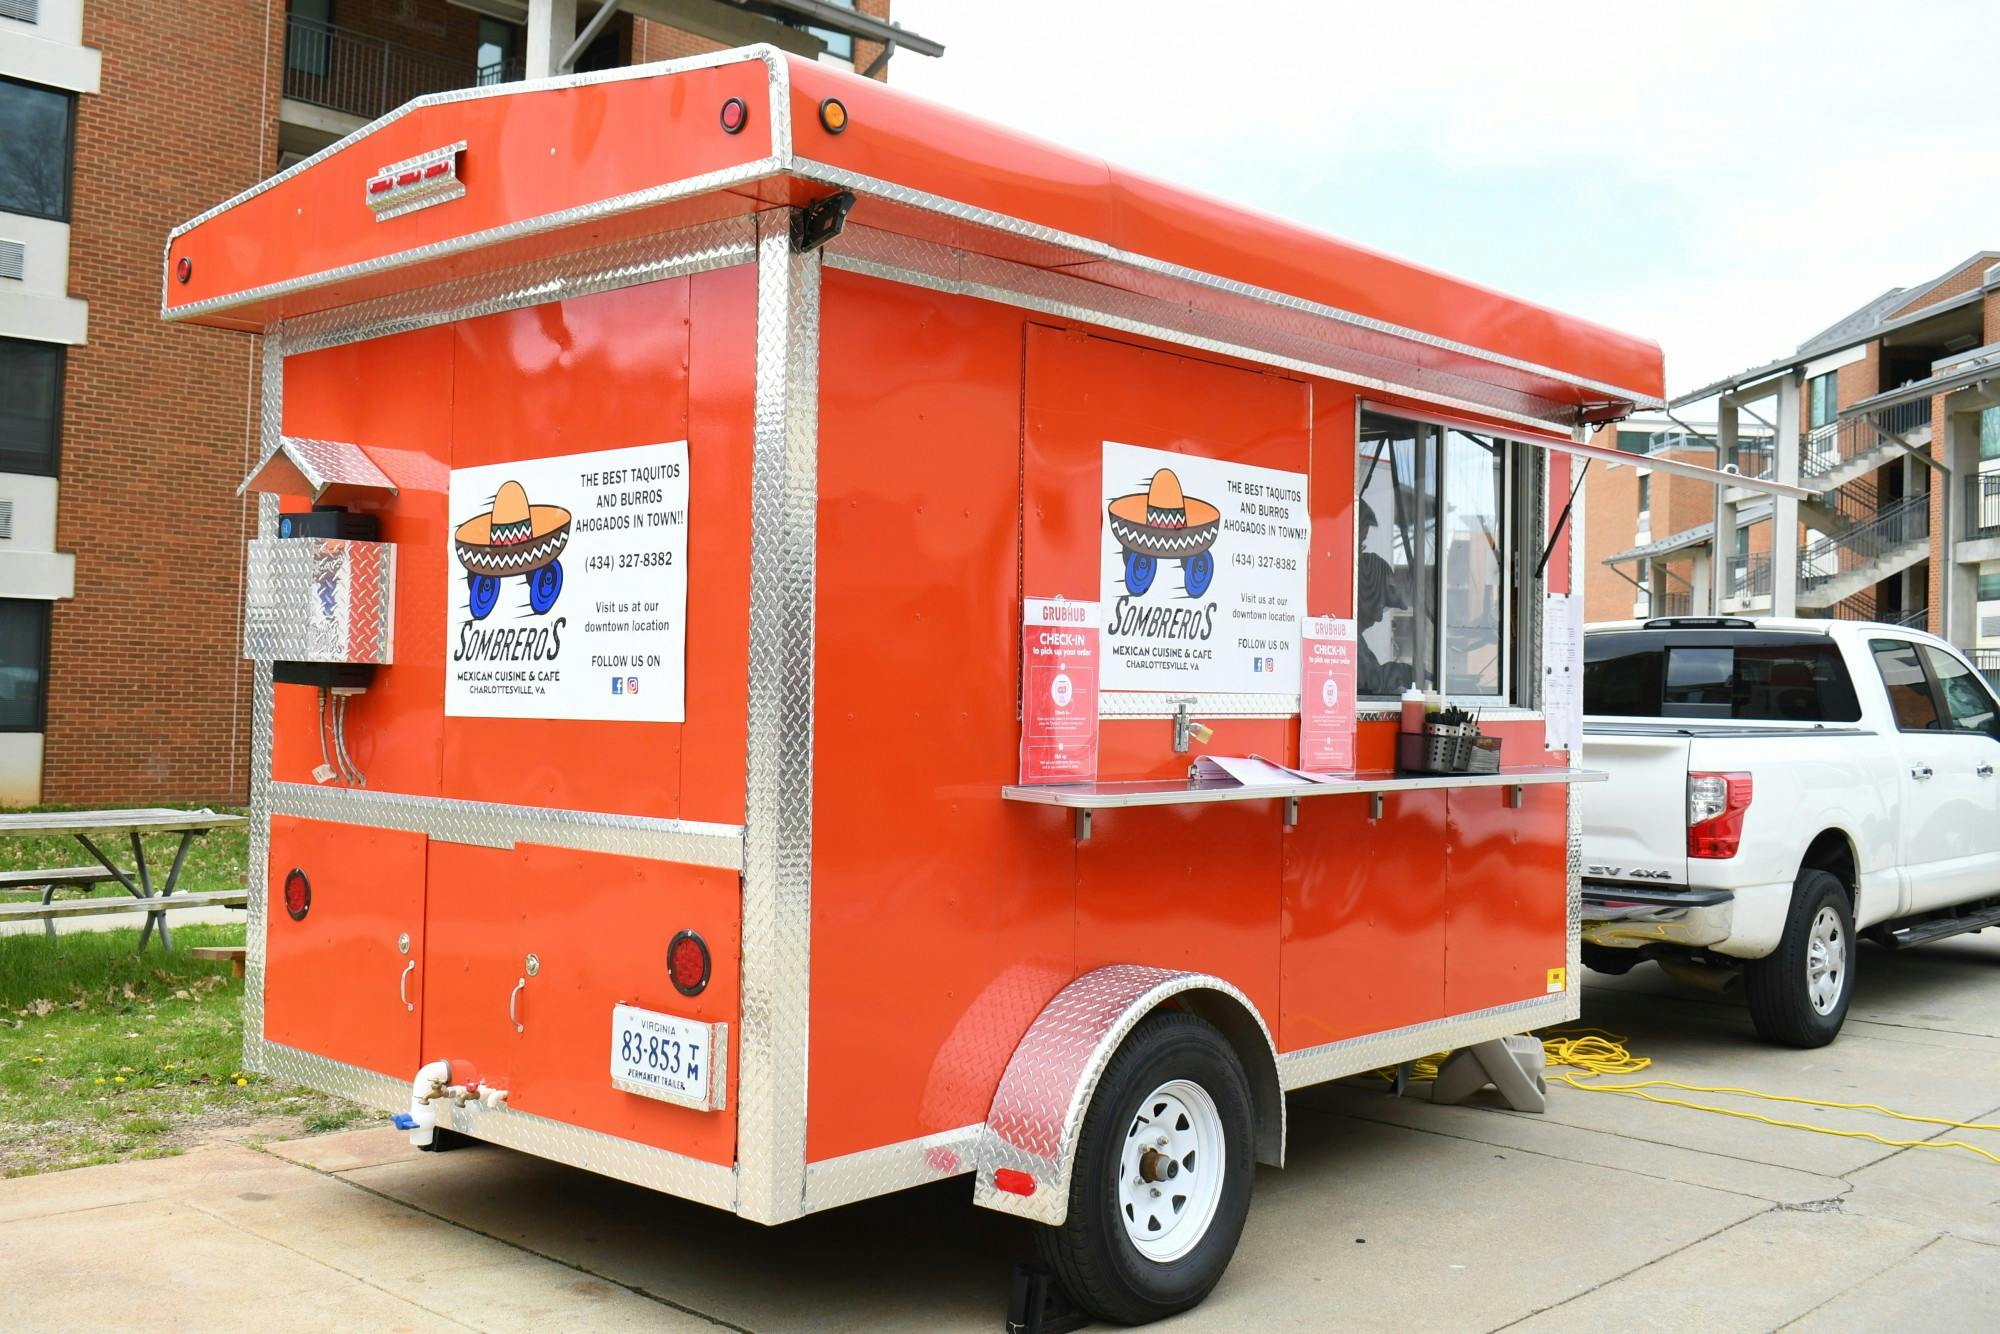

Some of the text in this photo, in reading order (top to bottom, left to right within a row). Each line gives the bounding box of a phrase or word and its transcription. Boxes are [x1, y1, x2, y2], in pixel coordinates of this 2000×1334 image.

[581, 464, 680, 487] THE BEST TAQUITOS
[1227, 480, 1301, 502] THE BEST TAQUITOS
[596, 489, 663, 508] AND BURROS
[1240, 502, 1289, 519] AND BURROS
[575, 510, 683, 533] AHOGADOS IN TOWN!!
[1224, 519, 1307, 540] AHOGADOS IN TOWN!!
[585, 551, 672, 573] (434) 327-8382
[1231, 553, 1296, 571] (434) 327-8382
[1240, 592, 1256, 603] Visit
[1258, 596, 1266, 604] us
[1268, 596, 1275, 605] at
[595, 601, 659, 613] Visit us at our
[1042, 606, 1086, 622] GRUBHUB
[1232, 608, 1295, 622] downtown location
[584, 619, 669, 632] downtown location
[1315, 622, 1347, 636] GRUBHUB
[1040, 632, 1085, 645] CHECK-IN
[1238, 638, 1289, 650] FOLLOW US ON
[1033, 647, 1039, 655] to
[1041, 646, 1053, 656] pick
[1077, 648, 1091, 656] order
[1113, 645, 1150, 656] MEXICAN
[1152, 647, 1182, 658] CUISINE
[1184, 648, 1190, 658] &
[1314, 644, 1346, 656] CHECK-IN
[591, 655, 660, 667] FOLLOW US ON
[1126, 660, 1200, 671] CHARLOTTESVILLE, VA
[457, 671, 492, 681] MEXICAN
[495, 671, 526, 681] CUISINE
[529, 671, 535, 681] &
[469, 685, 545, 695] CHARLOTTESVILLE, VA
[641, 1020, 676, 1036] VIRGINIA
[622, 1030, 681, 1074] 83-853
[628, 1068, 685, 1090] PERMANENT TRAILER
